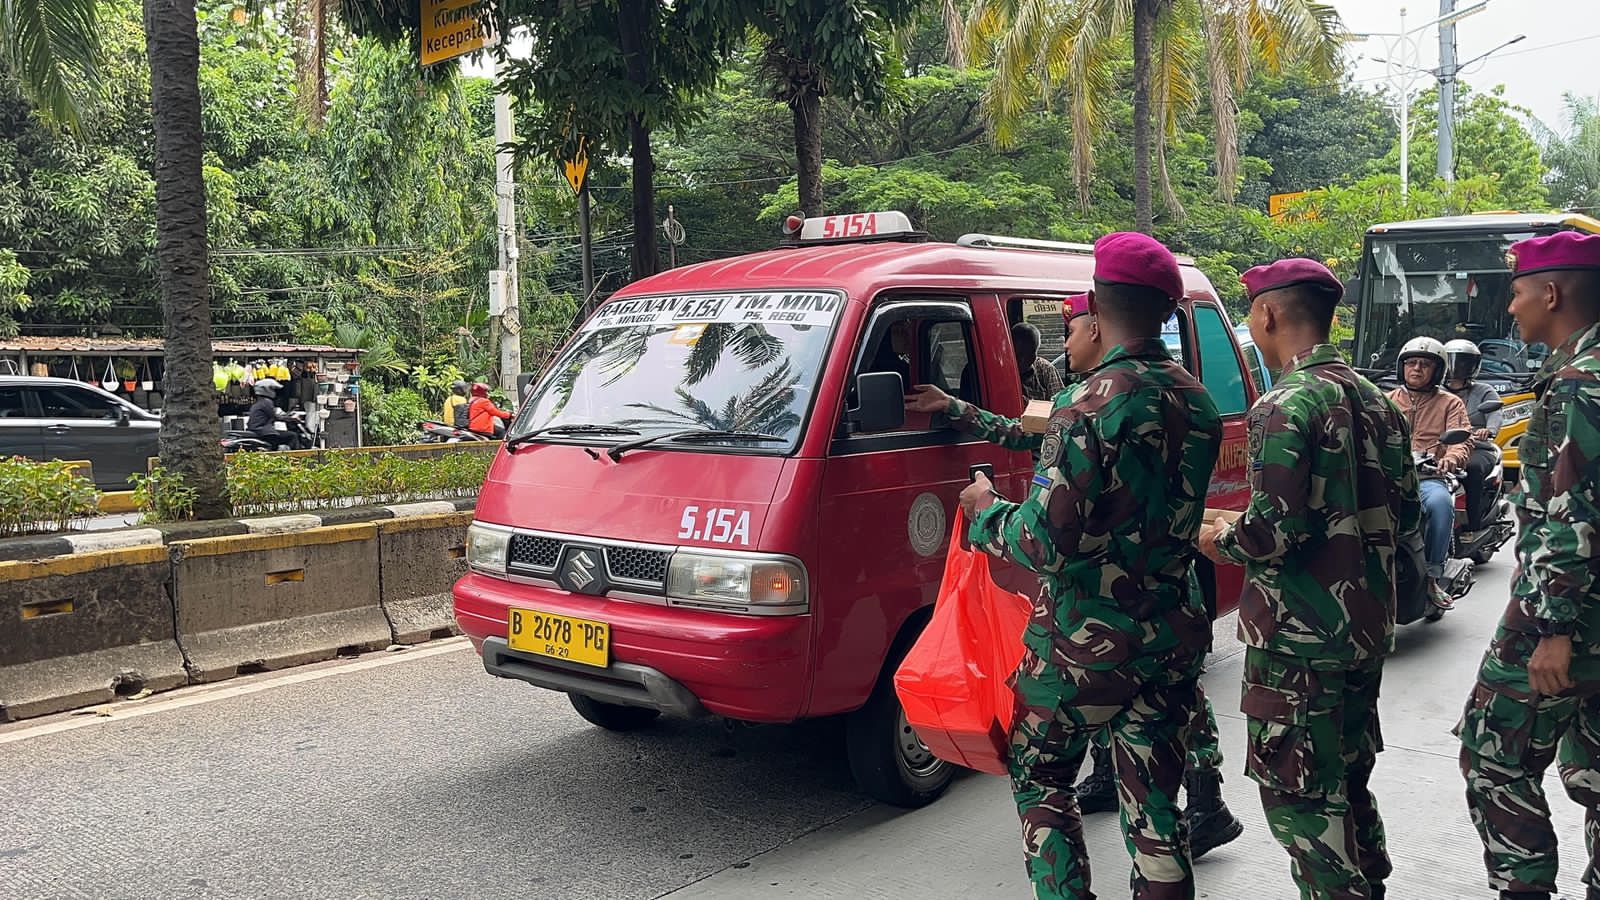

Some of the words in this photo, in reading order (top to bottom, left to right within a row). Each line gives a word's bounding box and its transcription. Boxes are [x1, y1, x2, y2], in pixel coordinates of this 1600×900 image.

[823, 214, 877, 238] S.15A
[597, 297, 682, 318] RAGUNAN
[677, 299, 725, 317] S.15A
[735, 295, 773, 309] TM.
[776, 295, 836, 312] MINI
[616, 313, 660, 324] MINGGU
[743, 311, 763, 320] PS.
[768, 311, 807, 321] REBO
[678, 506, 750, 545] S.15A
[512, 611, 522, 635] B
[533, 615, 572, 644] 2678
[584, 623, 605, 651] PG
